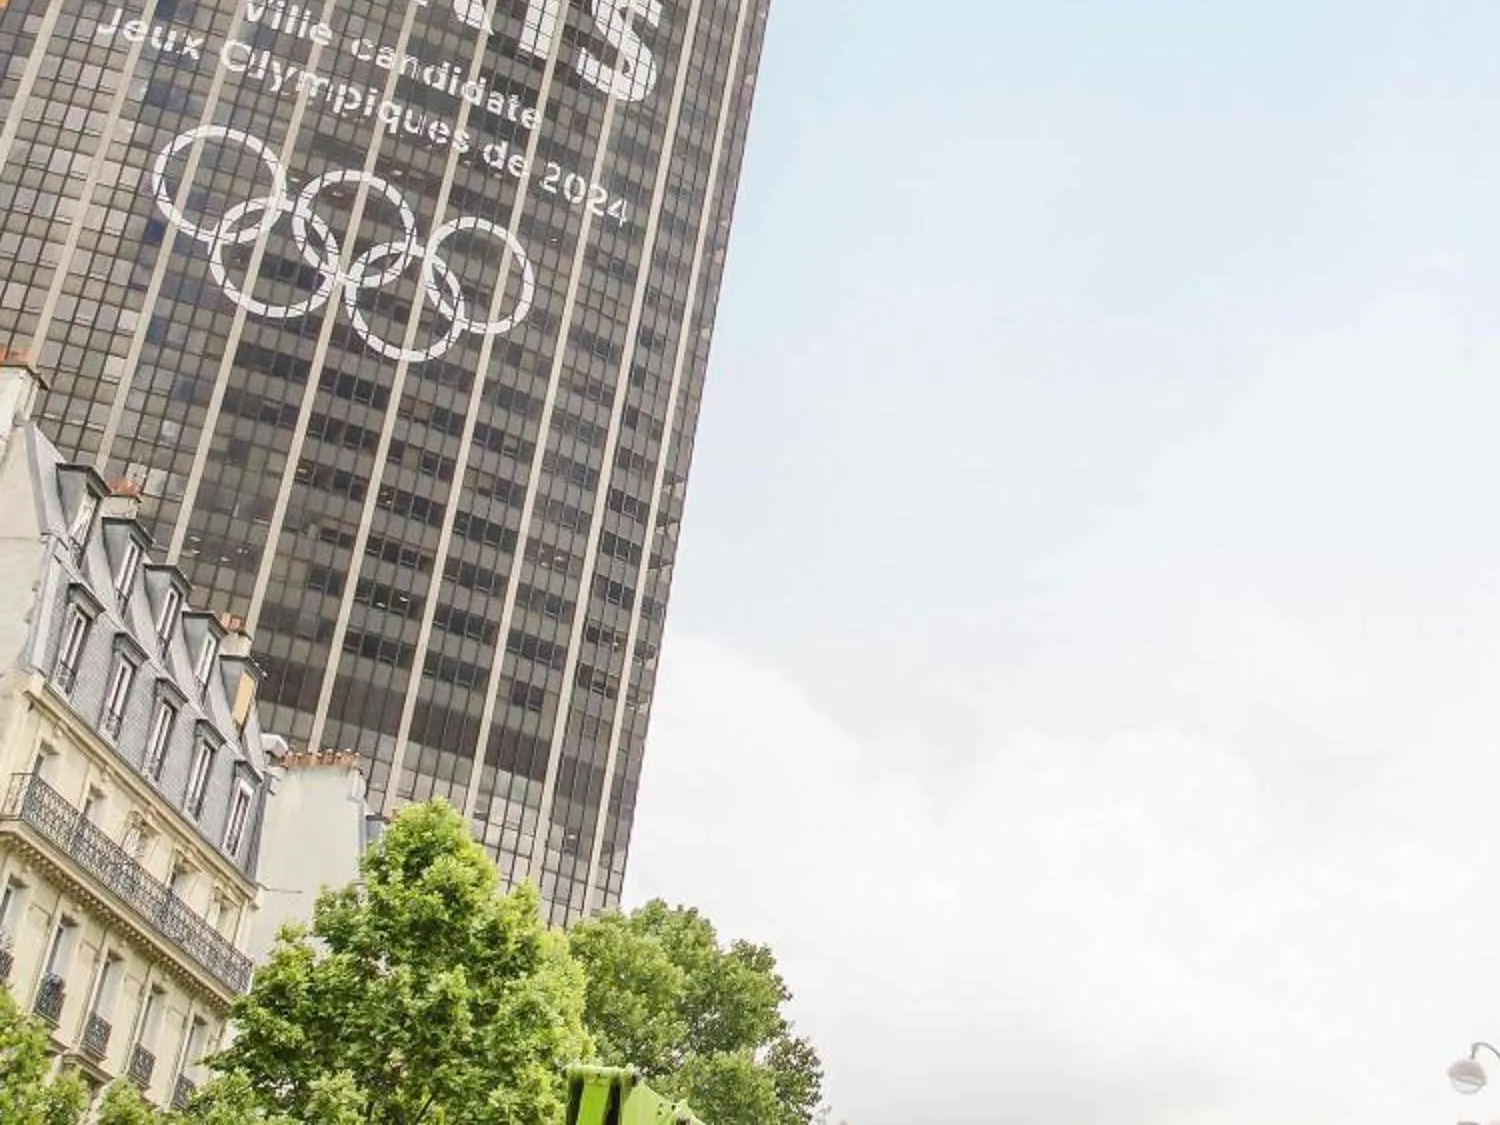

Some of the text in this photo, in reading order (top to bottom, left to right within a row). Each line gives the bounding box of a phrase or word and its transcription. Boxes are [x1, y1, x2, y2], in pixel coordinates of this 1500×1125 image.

[98, 8, 629, 227] Jeux Olympiques de 2024
[351, 38, 543, 131] candidate
